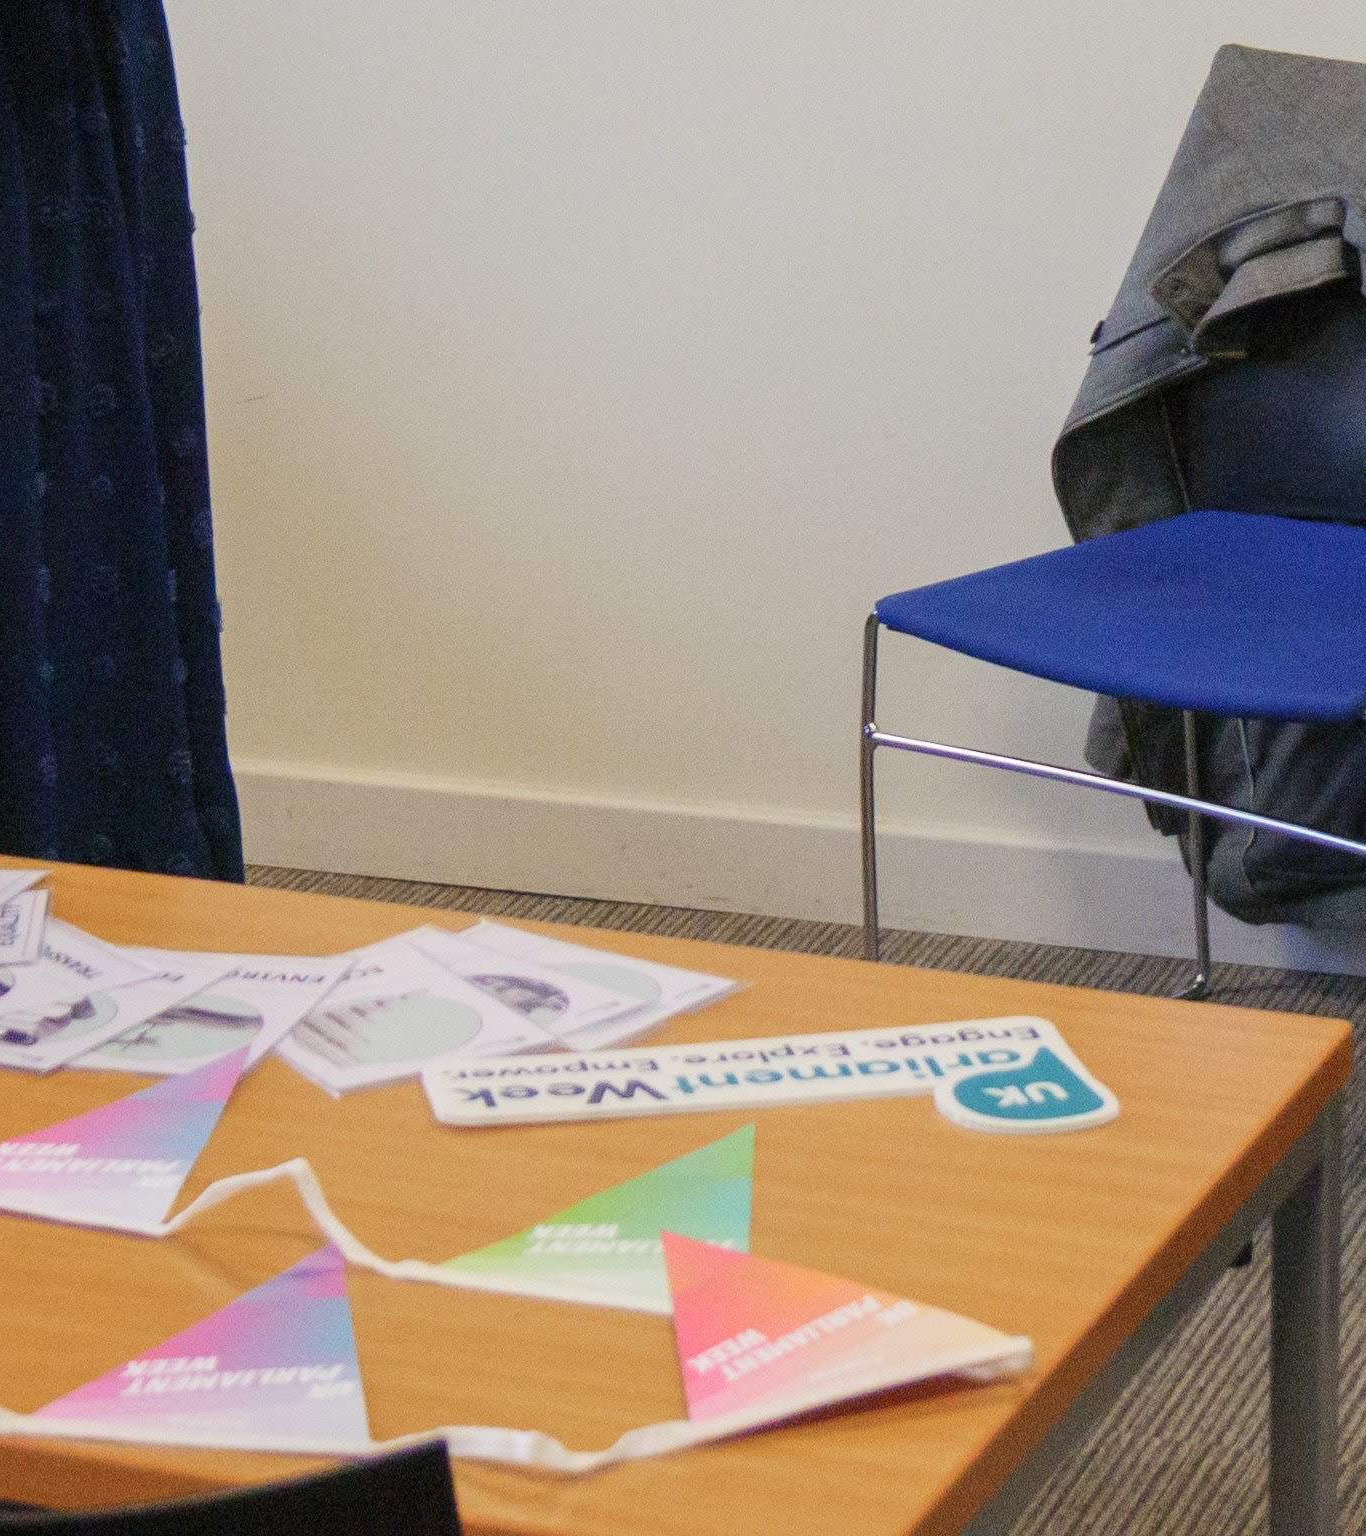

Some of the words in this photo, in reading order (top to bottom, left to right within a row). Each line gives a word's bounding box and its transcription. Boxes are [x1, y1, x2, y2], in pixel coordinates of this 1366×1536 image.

[861, 1026, 1041, 1049] Engage.
[670, 1042, 851, 1064] Explore.
[442, 1058, 661, 1078] Empower.
[454, 1078, 669, 1108] Week
[981, 1081, 1069, 1108] UK
[685, 1328, 767, 1374] WEEK
